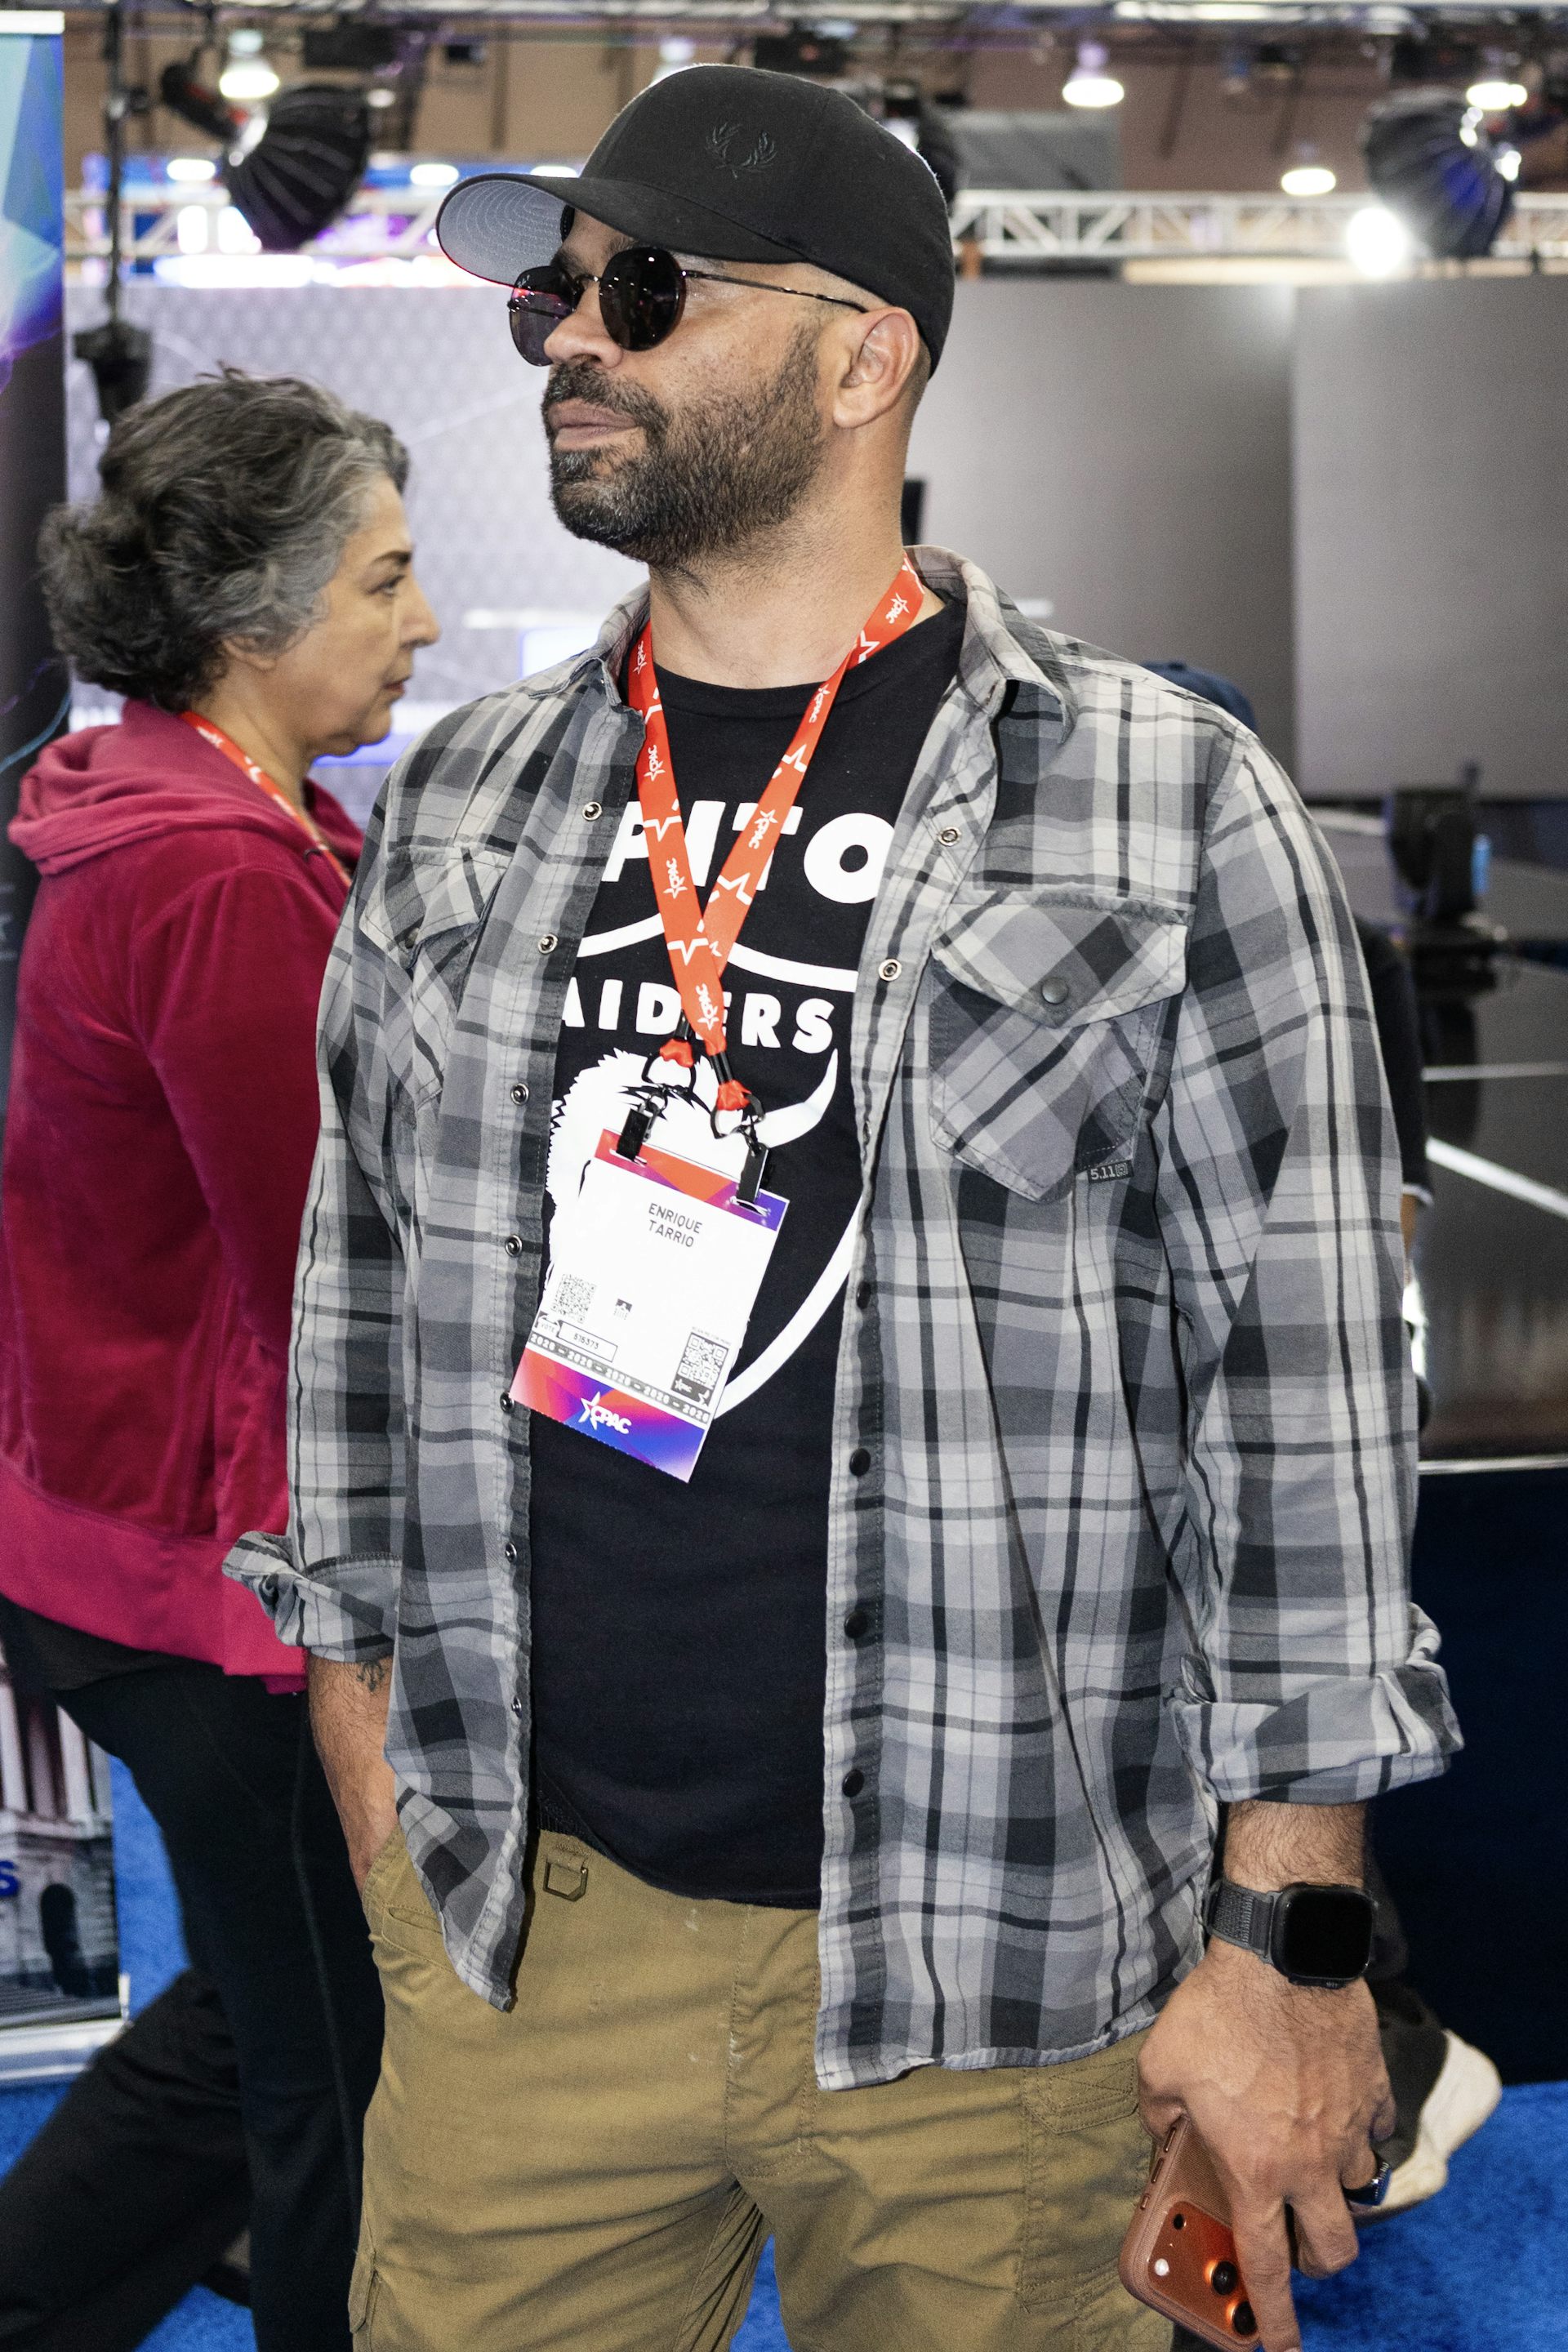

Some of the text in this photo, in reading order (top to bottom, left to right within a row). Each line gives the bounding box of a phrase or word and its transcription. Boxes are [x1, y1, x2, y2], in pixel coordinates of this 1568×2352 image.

[601, 800, 895, 904] PIO
[562, 977, 835, 1054] AIDRS
[1090, 1165, 1116, 1180] 5.11
[648, 1202, 702, 1234] ENRIQUE
[649, 1219, 694, 1247] TARRIO
[590, 1405, 632, 1435] CPAC
